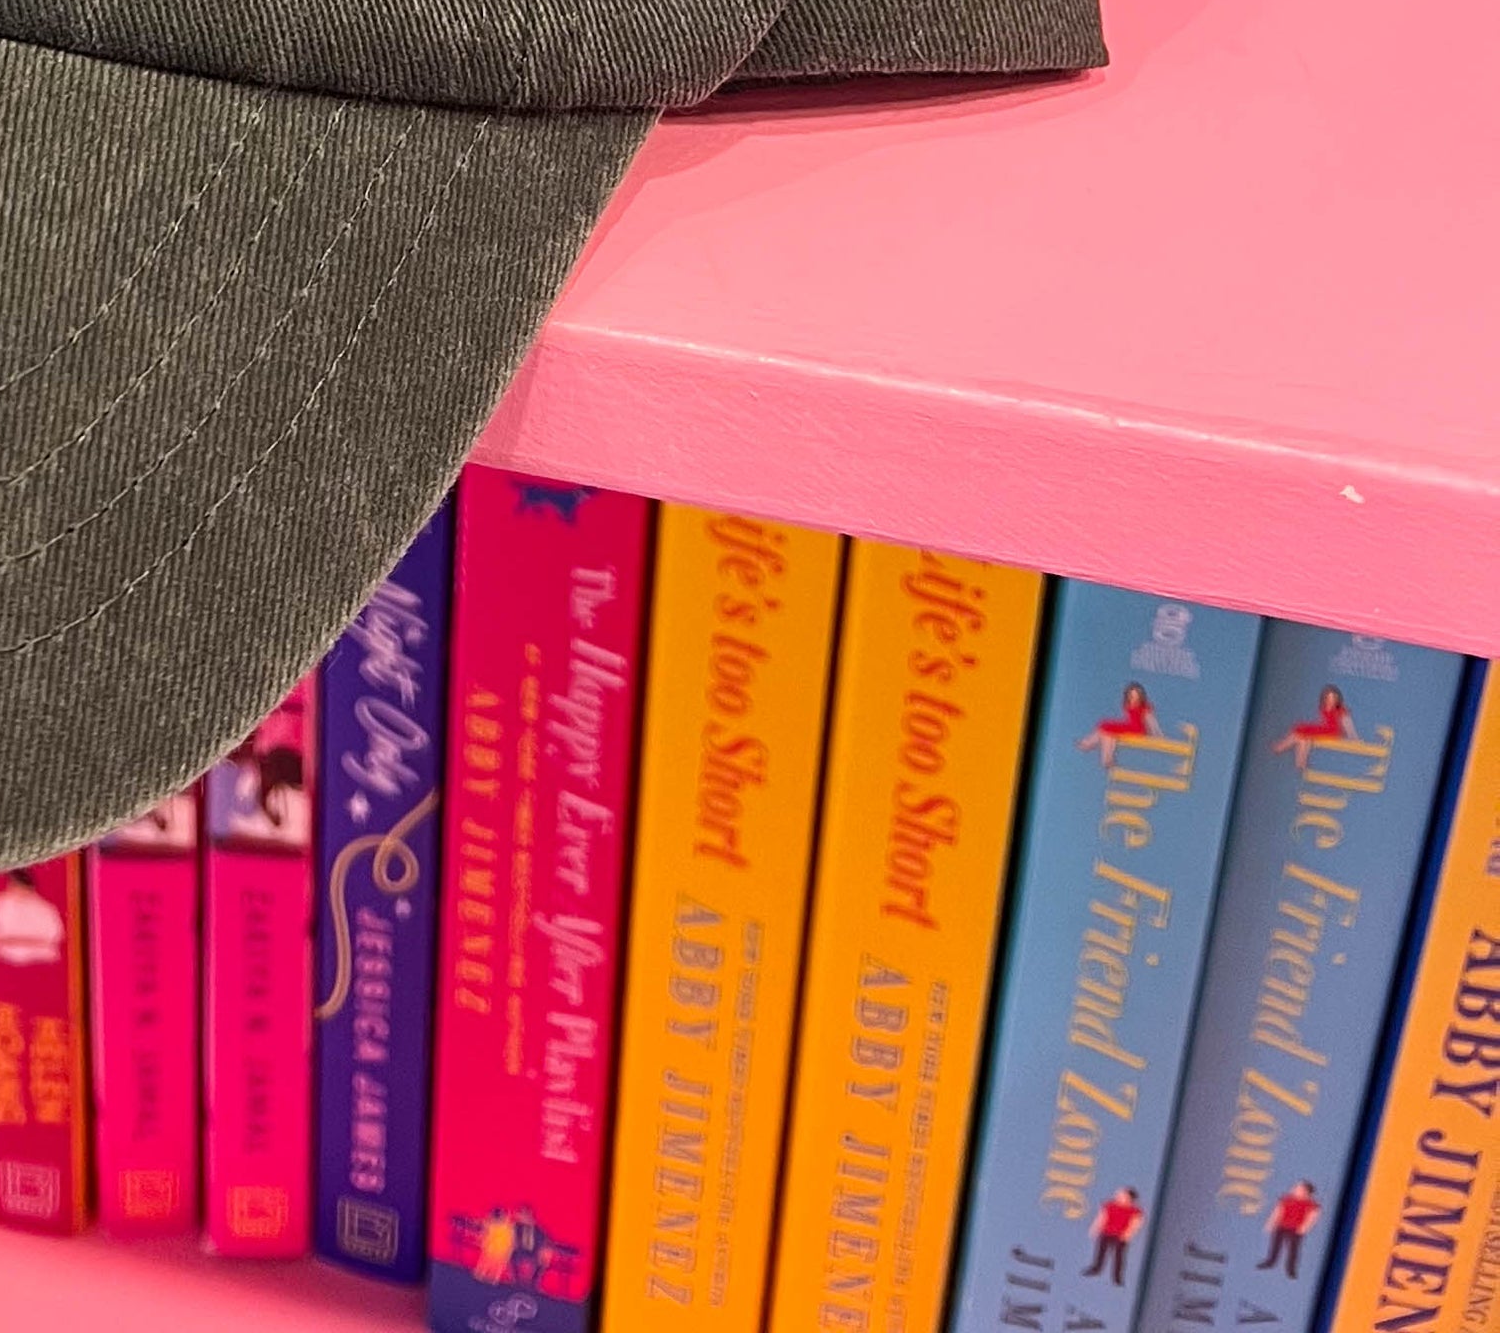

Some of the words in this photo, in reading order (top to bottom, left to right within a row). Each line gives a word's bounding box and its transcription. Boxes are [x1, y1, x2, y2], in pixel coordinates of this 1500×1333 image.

[569, 565, 617, 630] The
[705, 515, 789, 627] ife's
[461, 684, 501, 799] ABBY
[546, 636, 627, 789] Happy
[706, 632, 772, 718] too
[901, 689, 967, 776] too
[555, 789, 615, 896] Ever
[693, 719, 770, 871] Short
[880, 780, 963, 933] Short
[1100, 722, 1199, 851] The
[1291, 724, 1395, 850] The
[453, 816, 500, 1016] JIMENEZ
[666, 890, 725, 1051] ABBY
[1070, 856, 1171, 1071] Friend
[1254, 861, 1362, 1068] Friend
[526, 1010, 598, 1164] Playlist
[846, 951, 912, 1113] ABBY
[350, 1071, 388, 1193] JAMES
[645, 1068, 713, 1308] JIMENEZ
[1041, 1068, 1140, 1221] Zone
[1216, 1066, 1321, 1218] Zone
[818, 1131, 892, 1333] JIMENE
[1374, 1129, 1483, 1333] JIMEN
